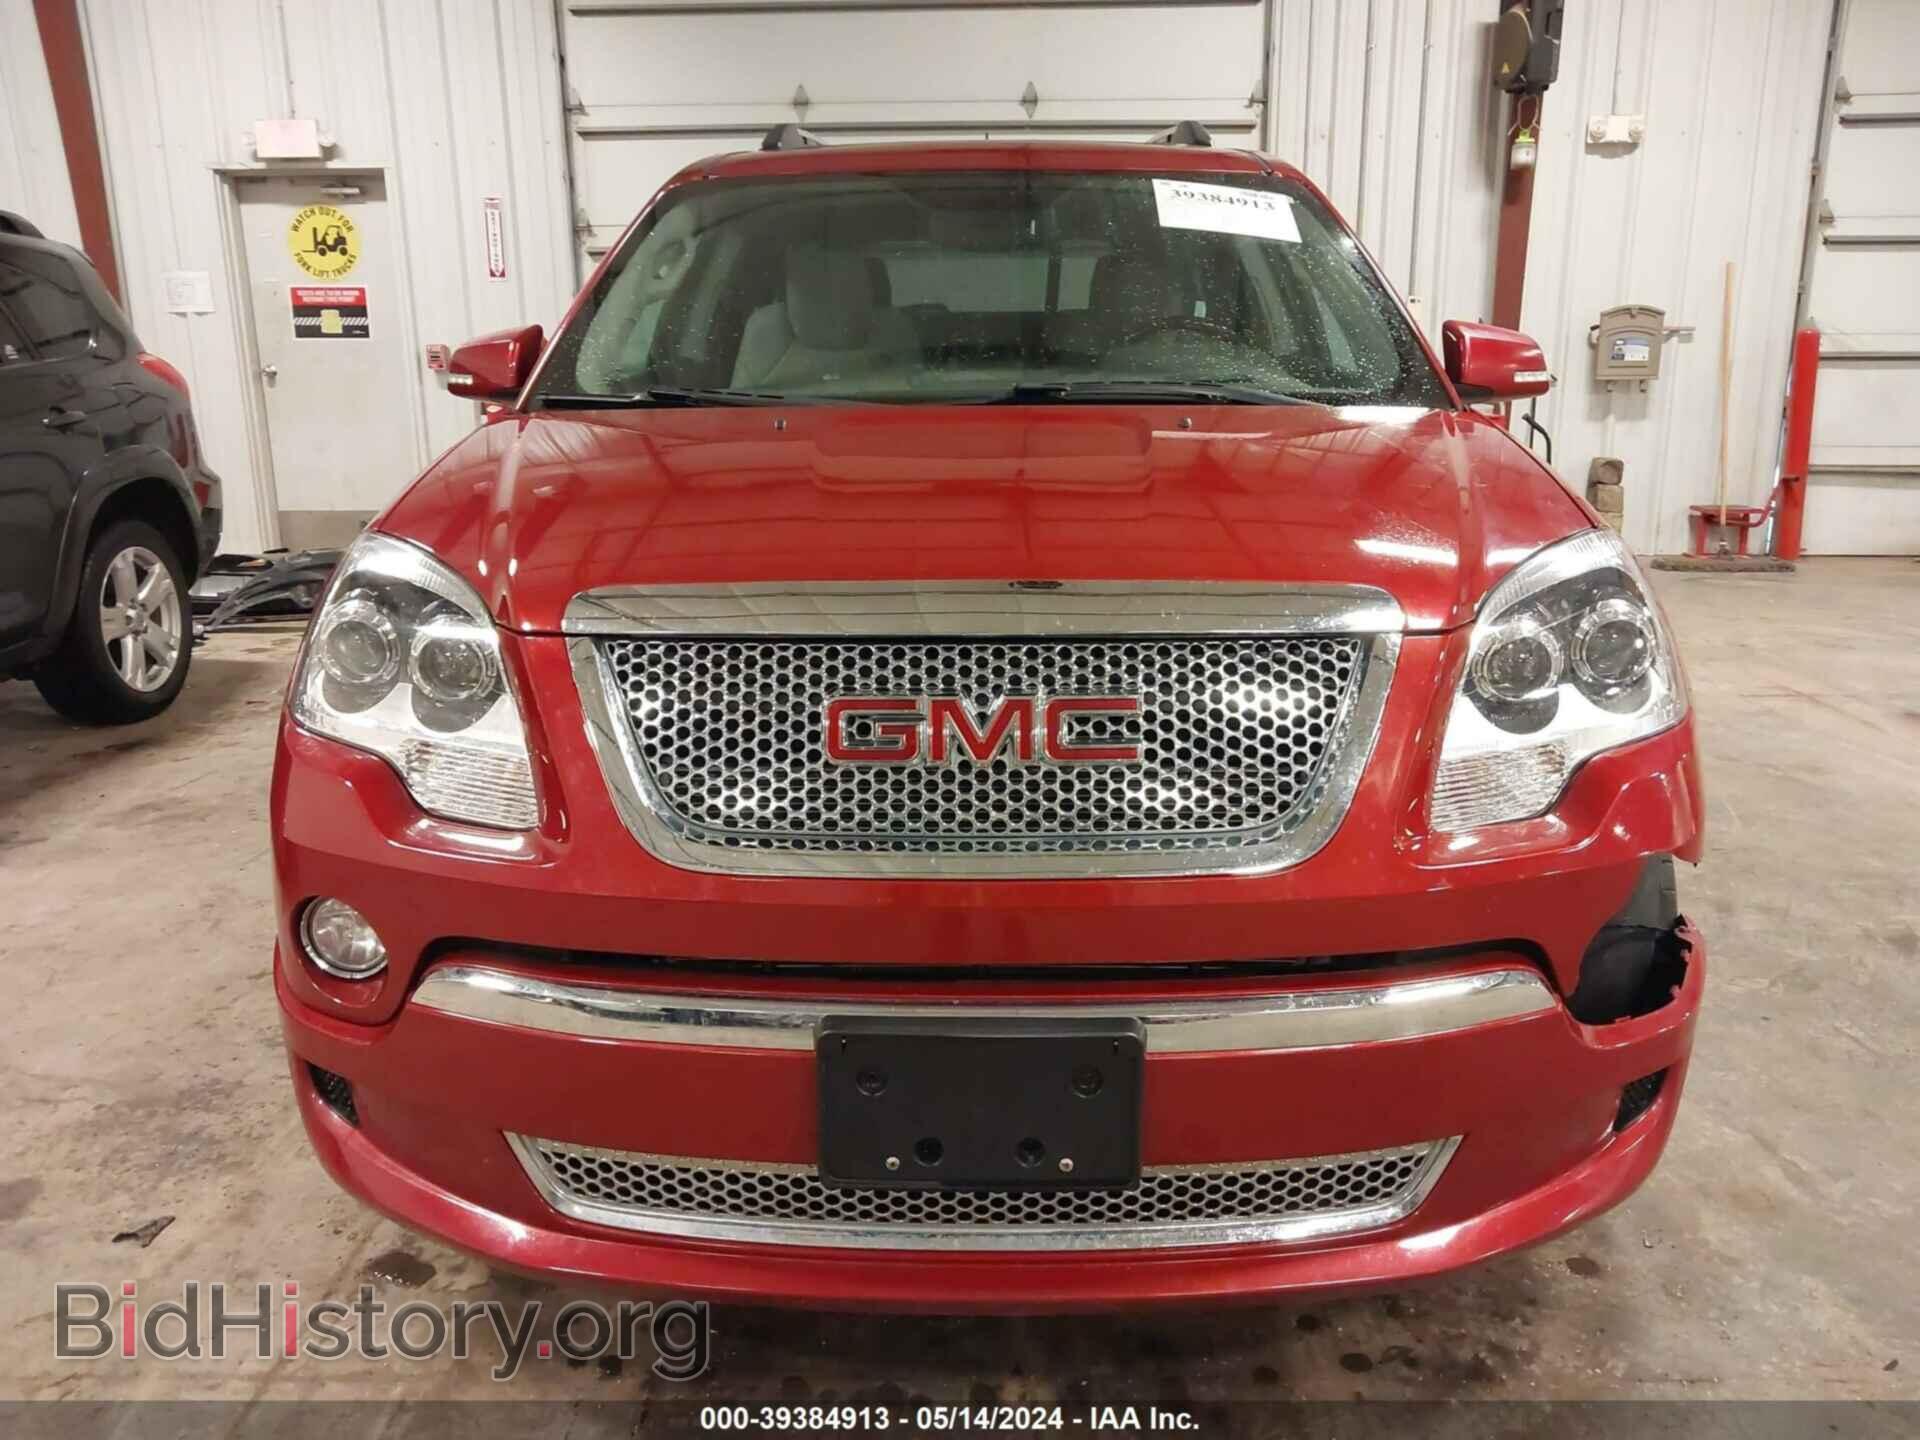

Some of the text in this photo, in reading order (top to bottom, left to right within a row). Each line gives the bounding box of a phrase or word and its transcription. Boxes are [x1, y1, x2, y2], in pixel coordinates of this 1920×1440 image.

[1171, 189, 1275, 211] 39384913
[291, 206, 354, 233] WATCH OUT FOR
[824, 694, 1143, 765] GMC
